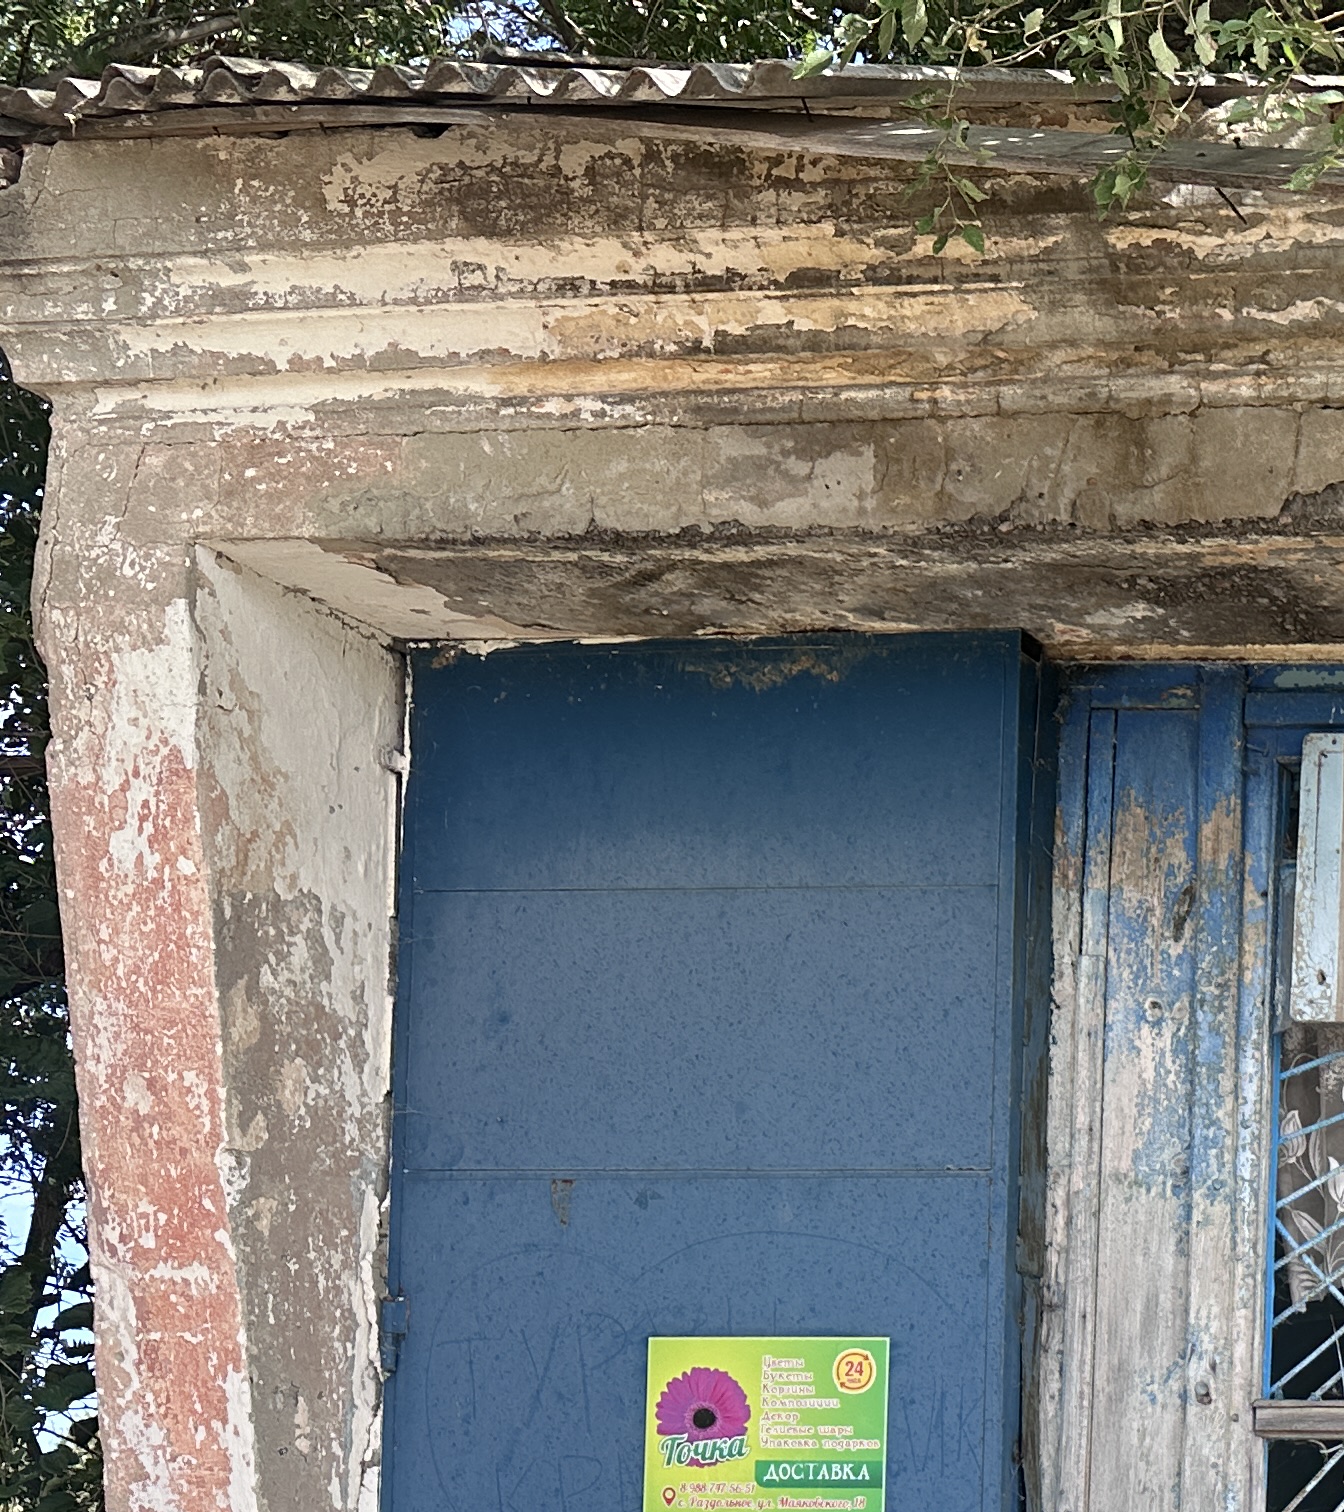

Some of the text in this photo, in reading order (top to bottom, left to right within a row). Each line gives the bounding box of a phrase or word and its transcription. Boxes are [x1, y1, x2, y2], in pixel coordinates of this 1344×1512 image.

[762, 1355, 804, 1368] Цветы
[844, 1360, 864, 1377] 24
[762, 1369, 813, 1382] Букеты
[761, 1383, 815, 1396] Корзины
[761, 1397, 839, 1409] Композиции
[761, 1410, 799, 1423] Декор
[760, 1424, 853, 1436] Гелиевые шары
[760, 1436, 880, 1450] Упаковка подарков
[659, 1434, 749, 1468] Точка
[762, 1463, 870, 1482] ДОСТАВКА
